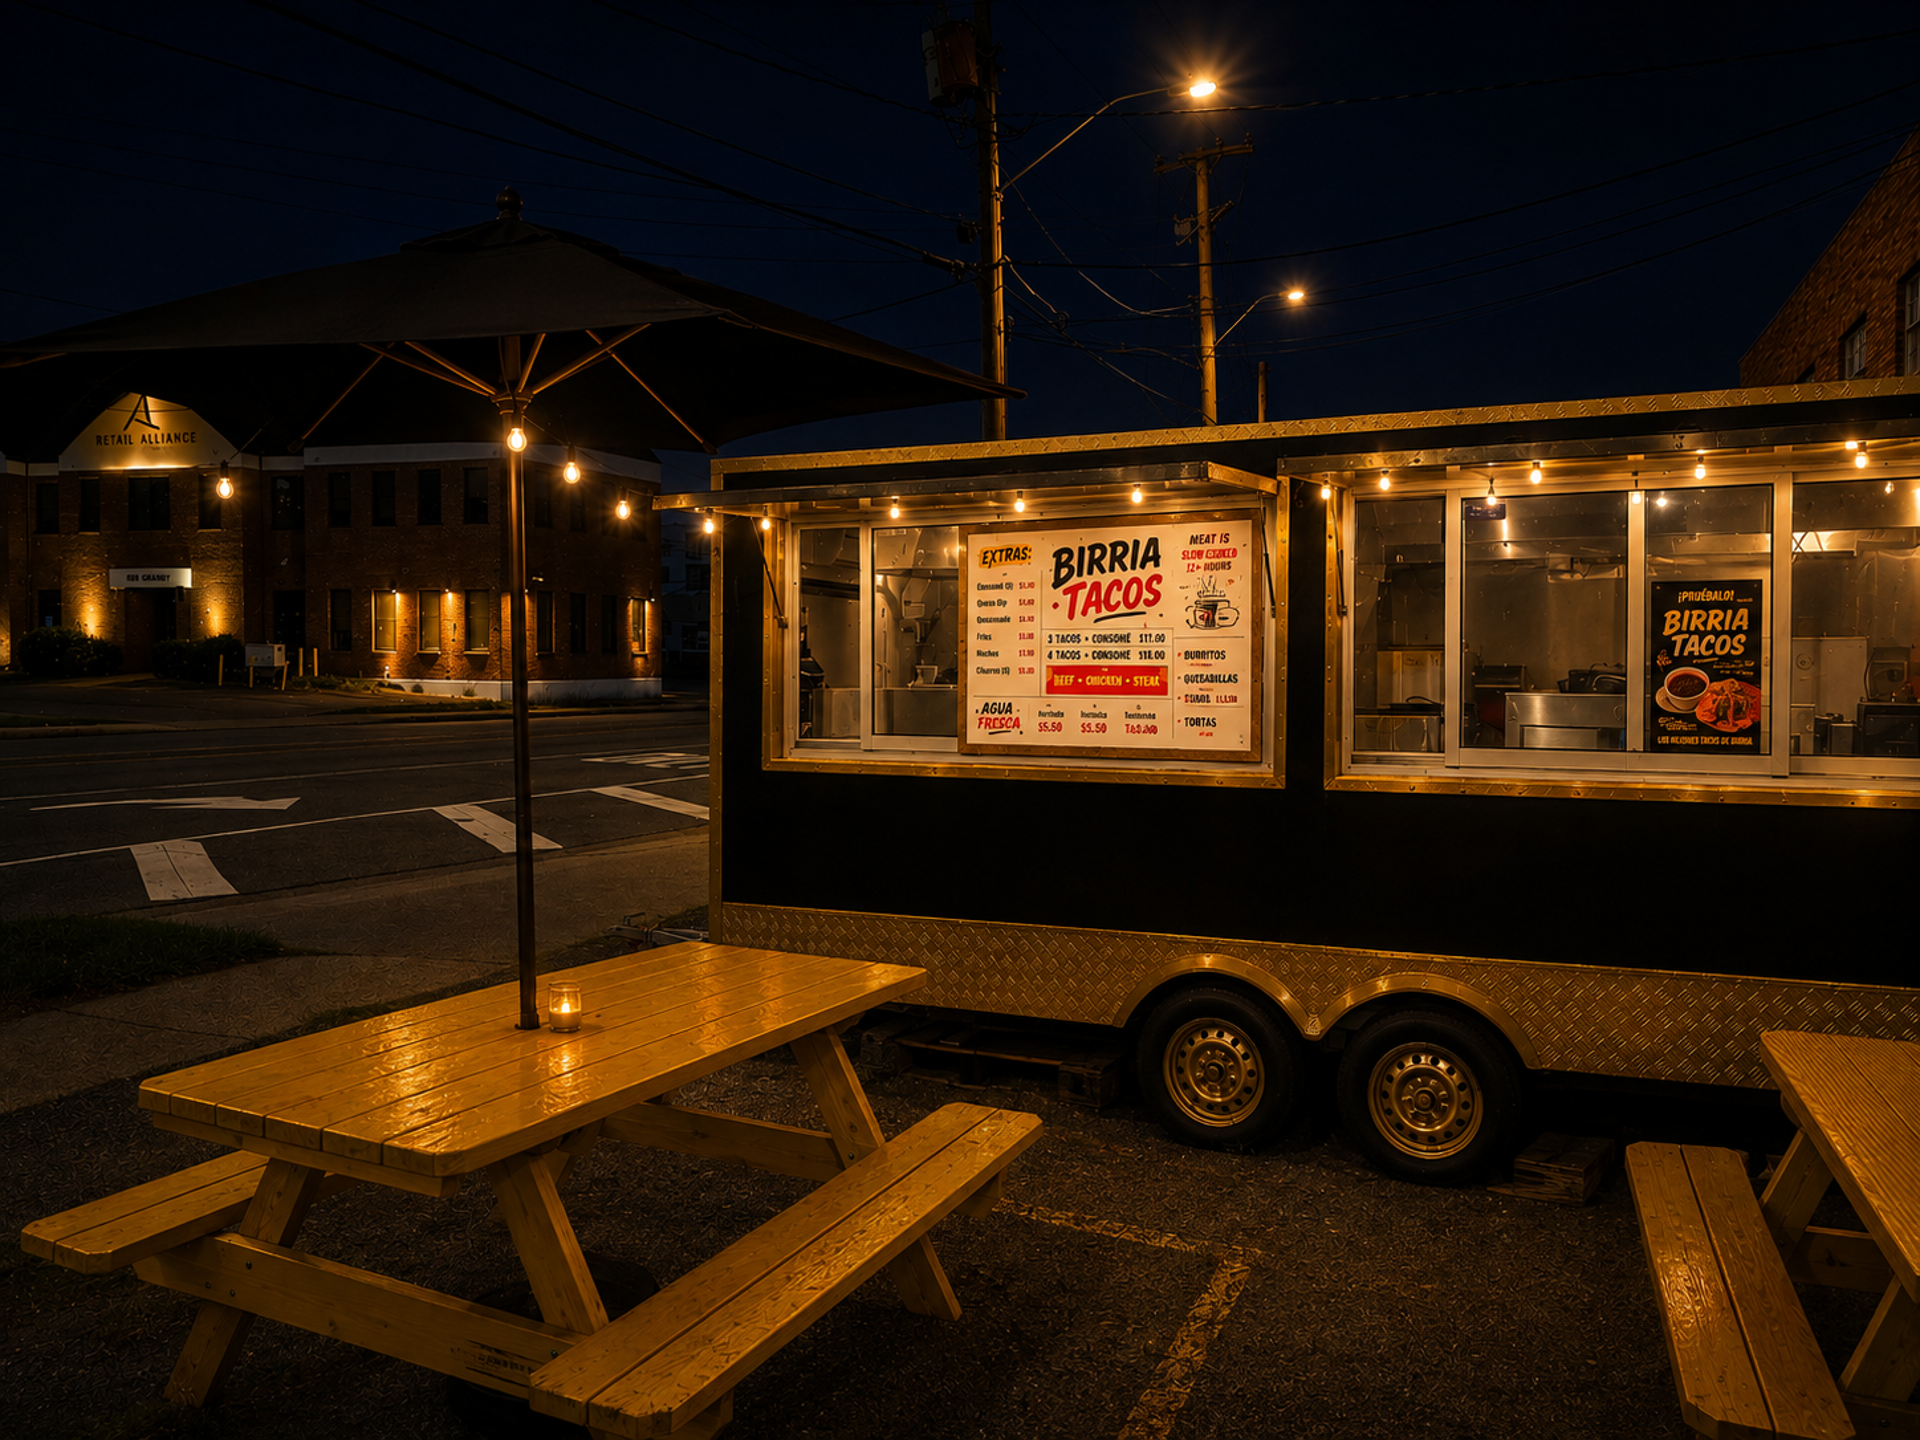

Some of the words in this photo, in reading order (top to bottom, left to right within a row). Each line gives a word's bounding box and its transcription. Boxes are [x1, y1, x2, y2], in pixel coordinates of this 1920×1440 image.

[95, 433, 134, 446] RETAIL
[140, 431, 197, 445] ALLIANCE
[1189, 533, 1217, 546] MEAT
[1219, 532, 1230, 544] IS
[1052, 537, 1162, 590] BIRRIA
[1062, 574, 1163, 621] TACOS
[1662, 608, 1749, 636] BIRRIA
[1055, 633, 1082, 644] TACOS
[1671, 633, 1747, 657] TACOS
[1047, 650, 1053, 660] 4
[1055, 650, 1081, 660] TACOS
[981, 702, 1013, 715] AGUA
[978, 716, 1020, 729] FRESCA
[1184, 716, 1217, 728] TORTAS
